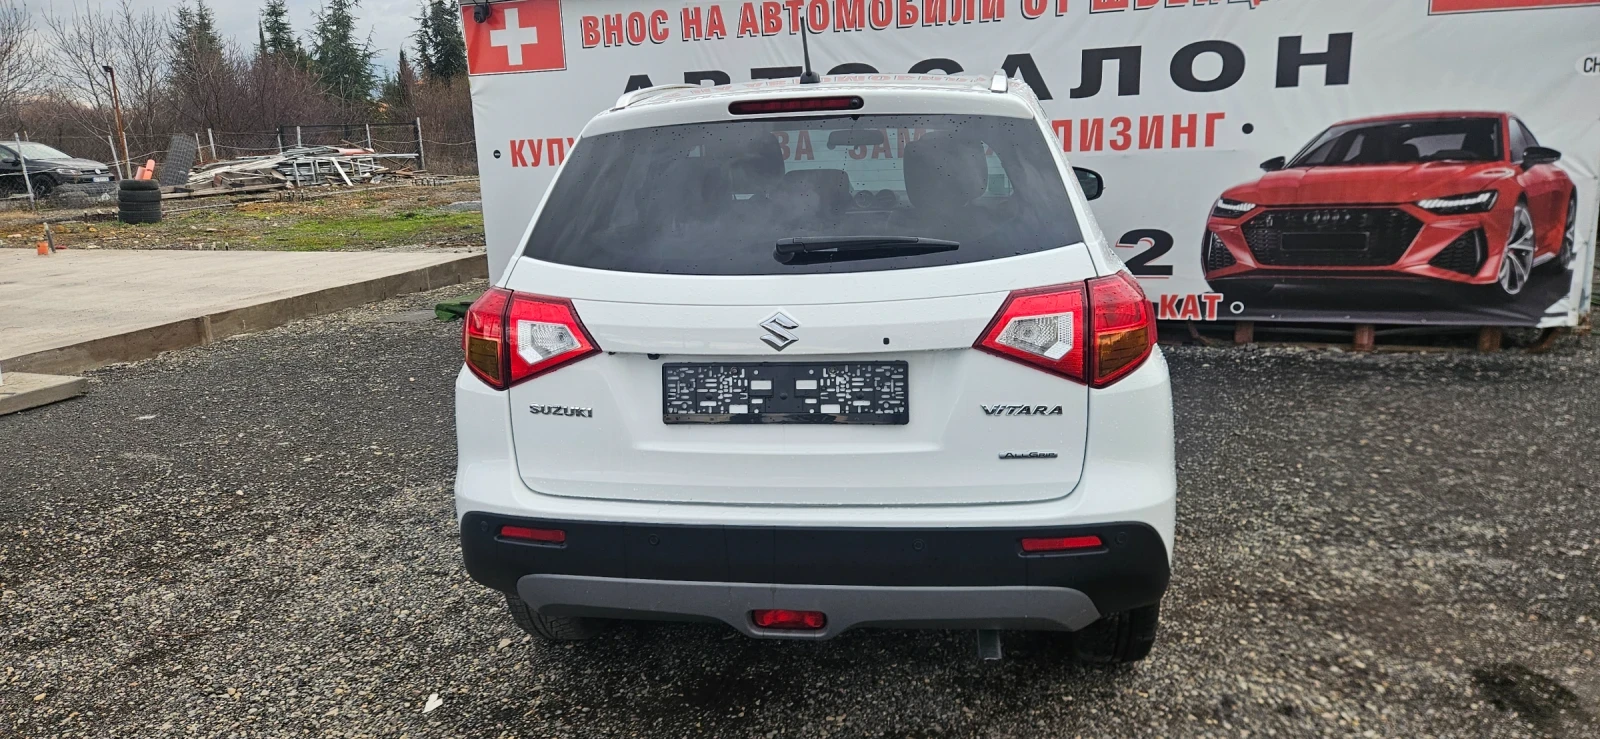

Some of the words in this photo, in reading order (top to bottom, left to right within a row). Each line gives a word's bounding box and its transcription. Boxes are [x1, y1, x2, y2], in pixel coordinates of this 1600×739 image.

[580, 9, 670, 49] ВНОС
[680, 5, 727, 42] НА
[736, 0, 1005, 38] АВТОМОБИЛИ
[1158, 292, 1223, 321] КАТ
[529, 403, 594, 418] SUZUKI
[980, 404, 1064, 416] VITARA
